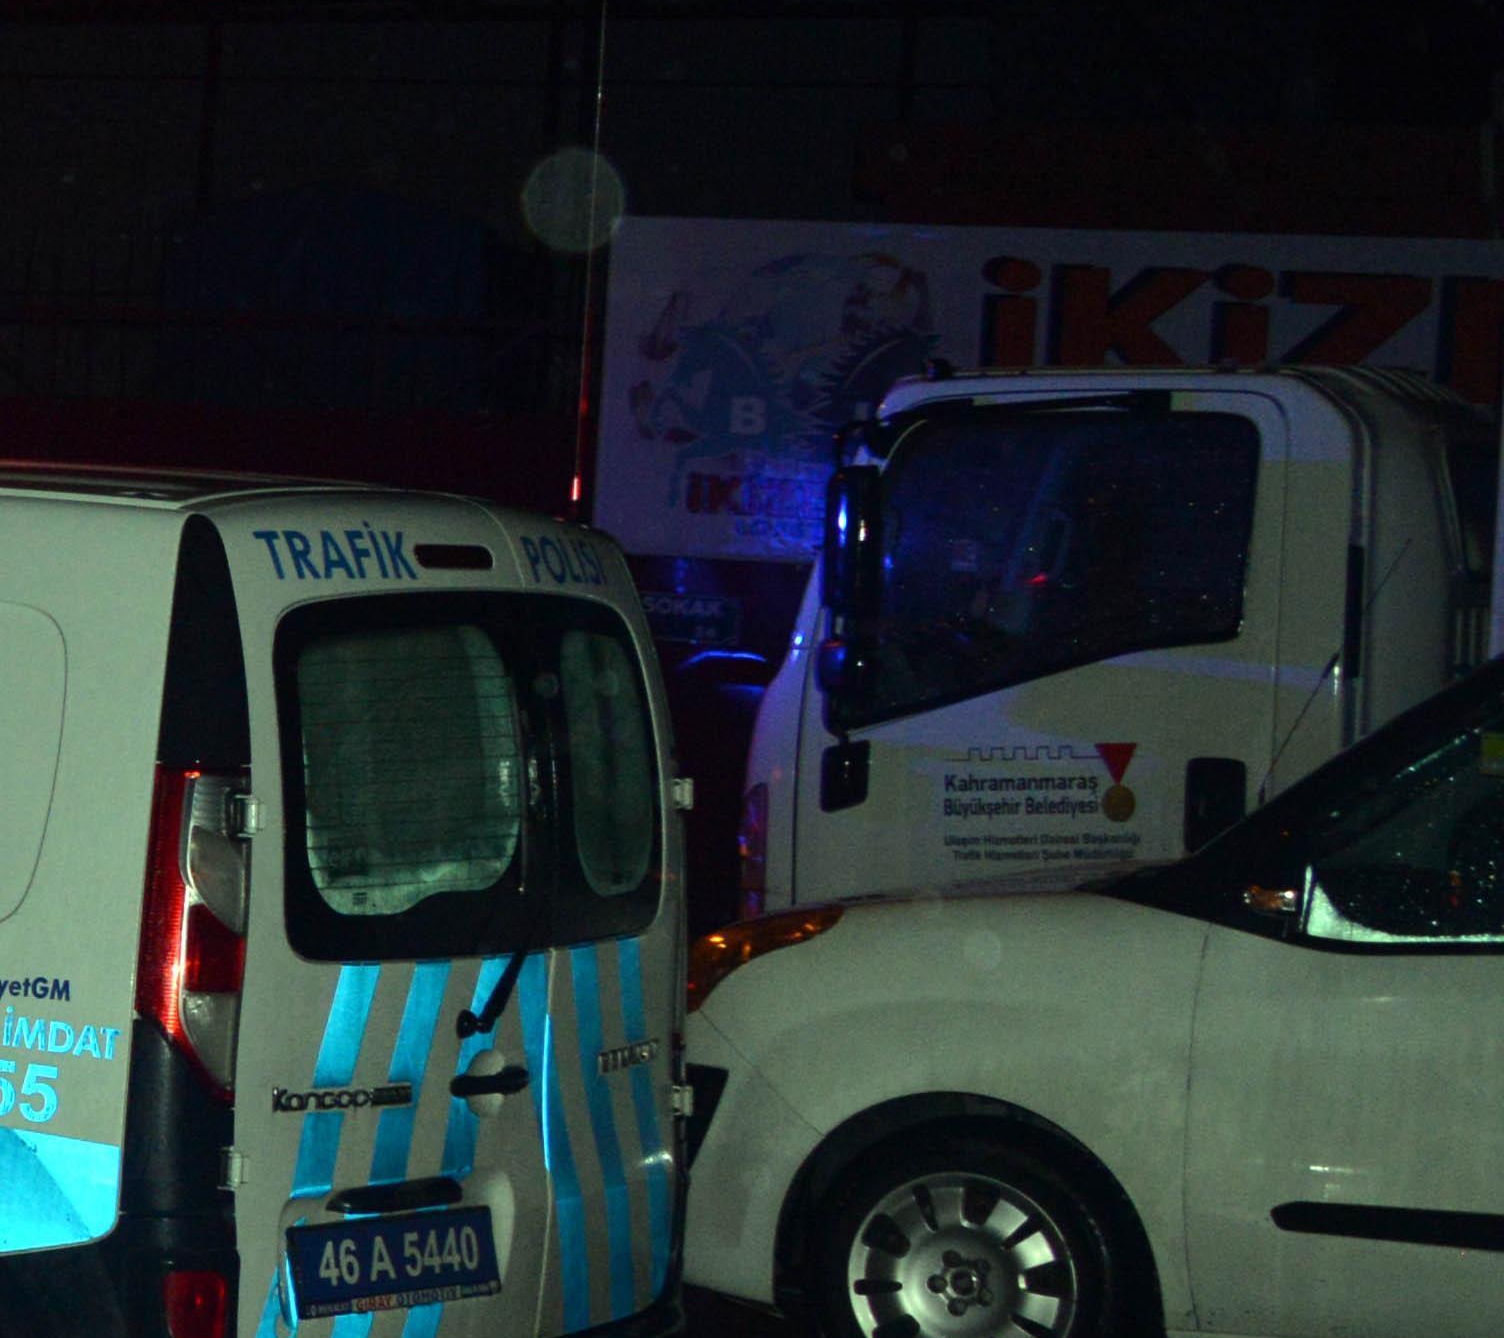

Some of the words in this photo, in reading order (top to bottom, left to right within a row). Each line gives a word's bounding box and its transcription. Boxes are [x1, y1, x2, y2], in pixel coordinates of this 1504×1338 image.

[253, 520, 419, 579] TRAFİK
[943, 796, 1021, 819] Büyükşehir
[1025, 795, 1099, 819] Belediyesi
[944, 773, 1099, 795] Kahramanmaraş
[2, 1005, 122, 1061] İMDAT
[318, 1238, 360, 1286] 46
[370, 1235, 397, 1283] A
[403, 1225, 479, 1278] 5440
